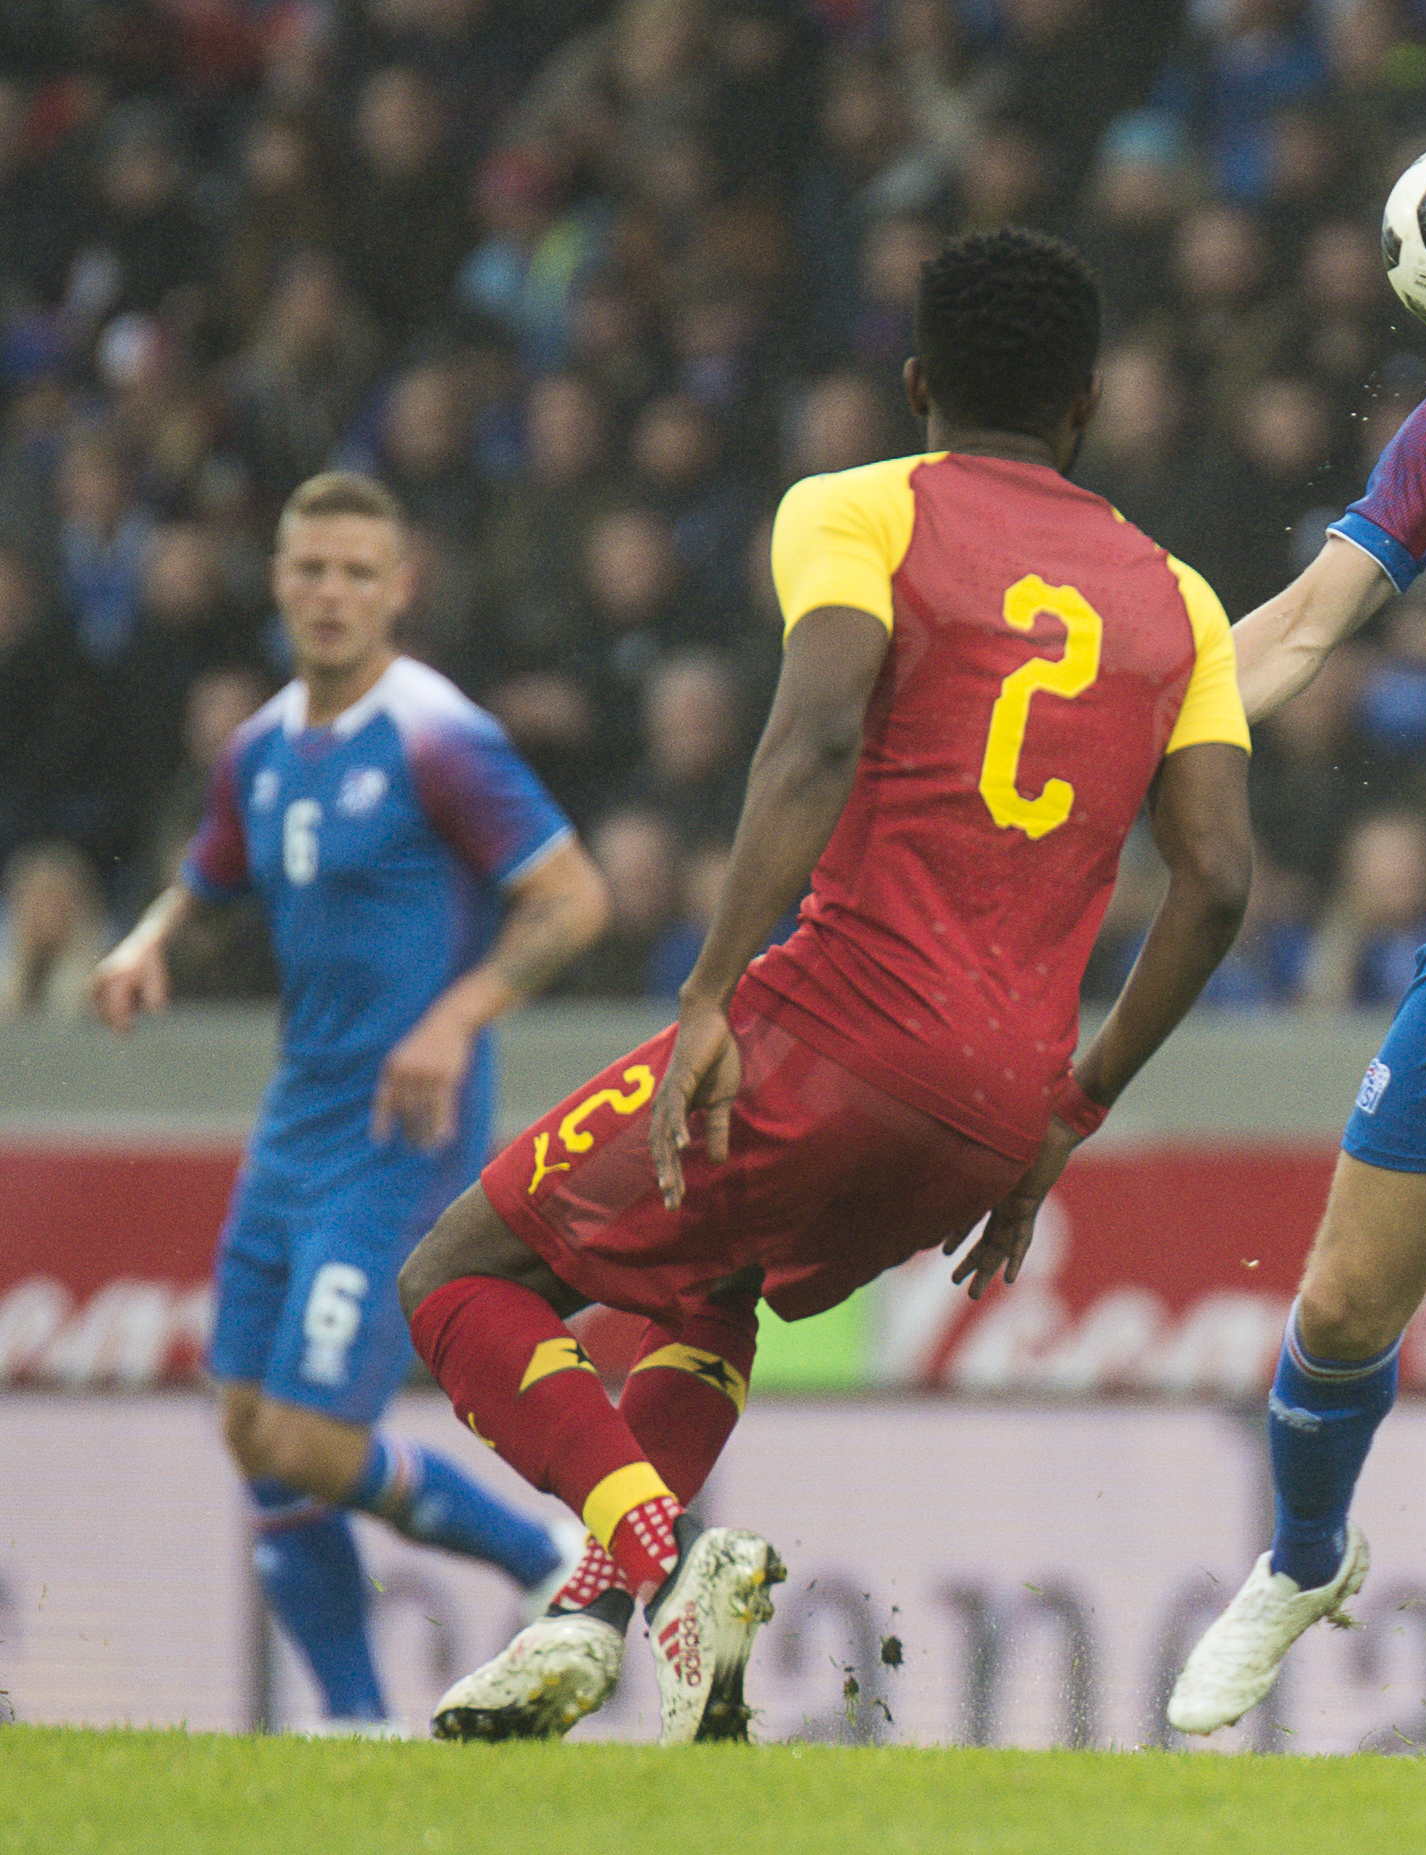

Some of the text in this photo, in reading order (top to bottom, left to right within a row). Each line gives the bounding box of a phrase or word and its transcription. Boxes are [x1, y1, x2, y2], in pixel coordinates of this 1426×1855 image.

[979, 574, 1103, 840] 2
[284, 799, 321, 885] 6
[558, 1065, 655, 1153] 2
[304, 1261, 368, 1346] 6
[684, 1600, 702, 1687] adidas
